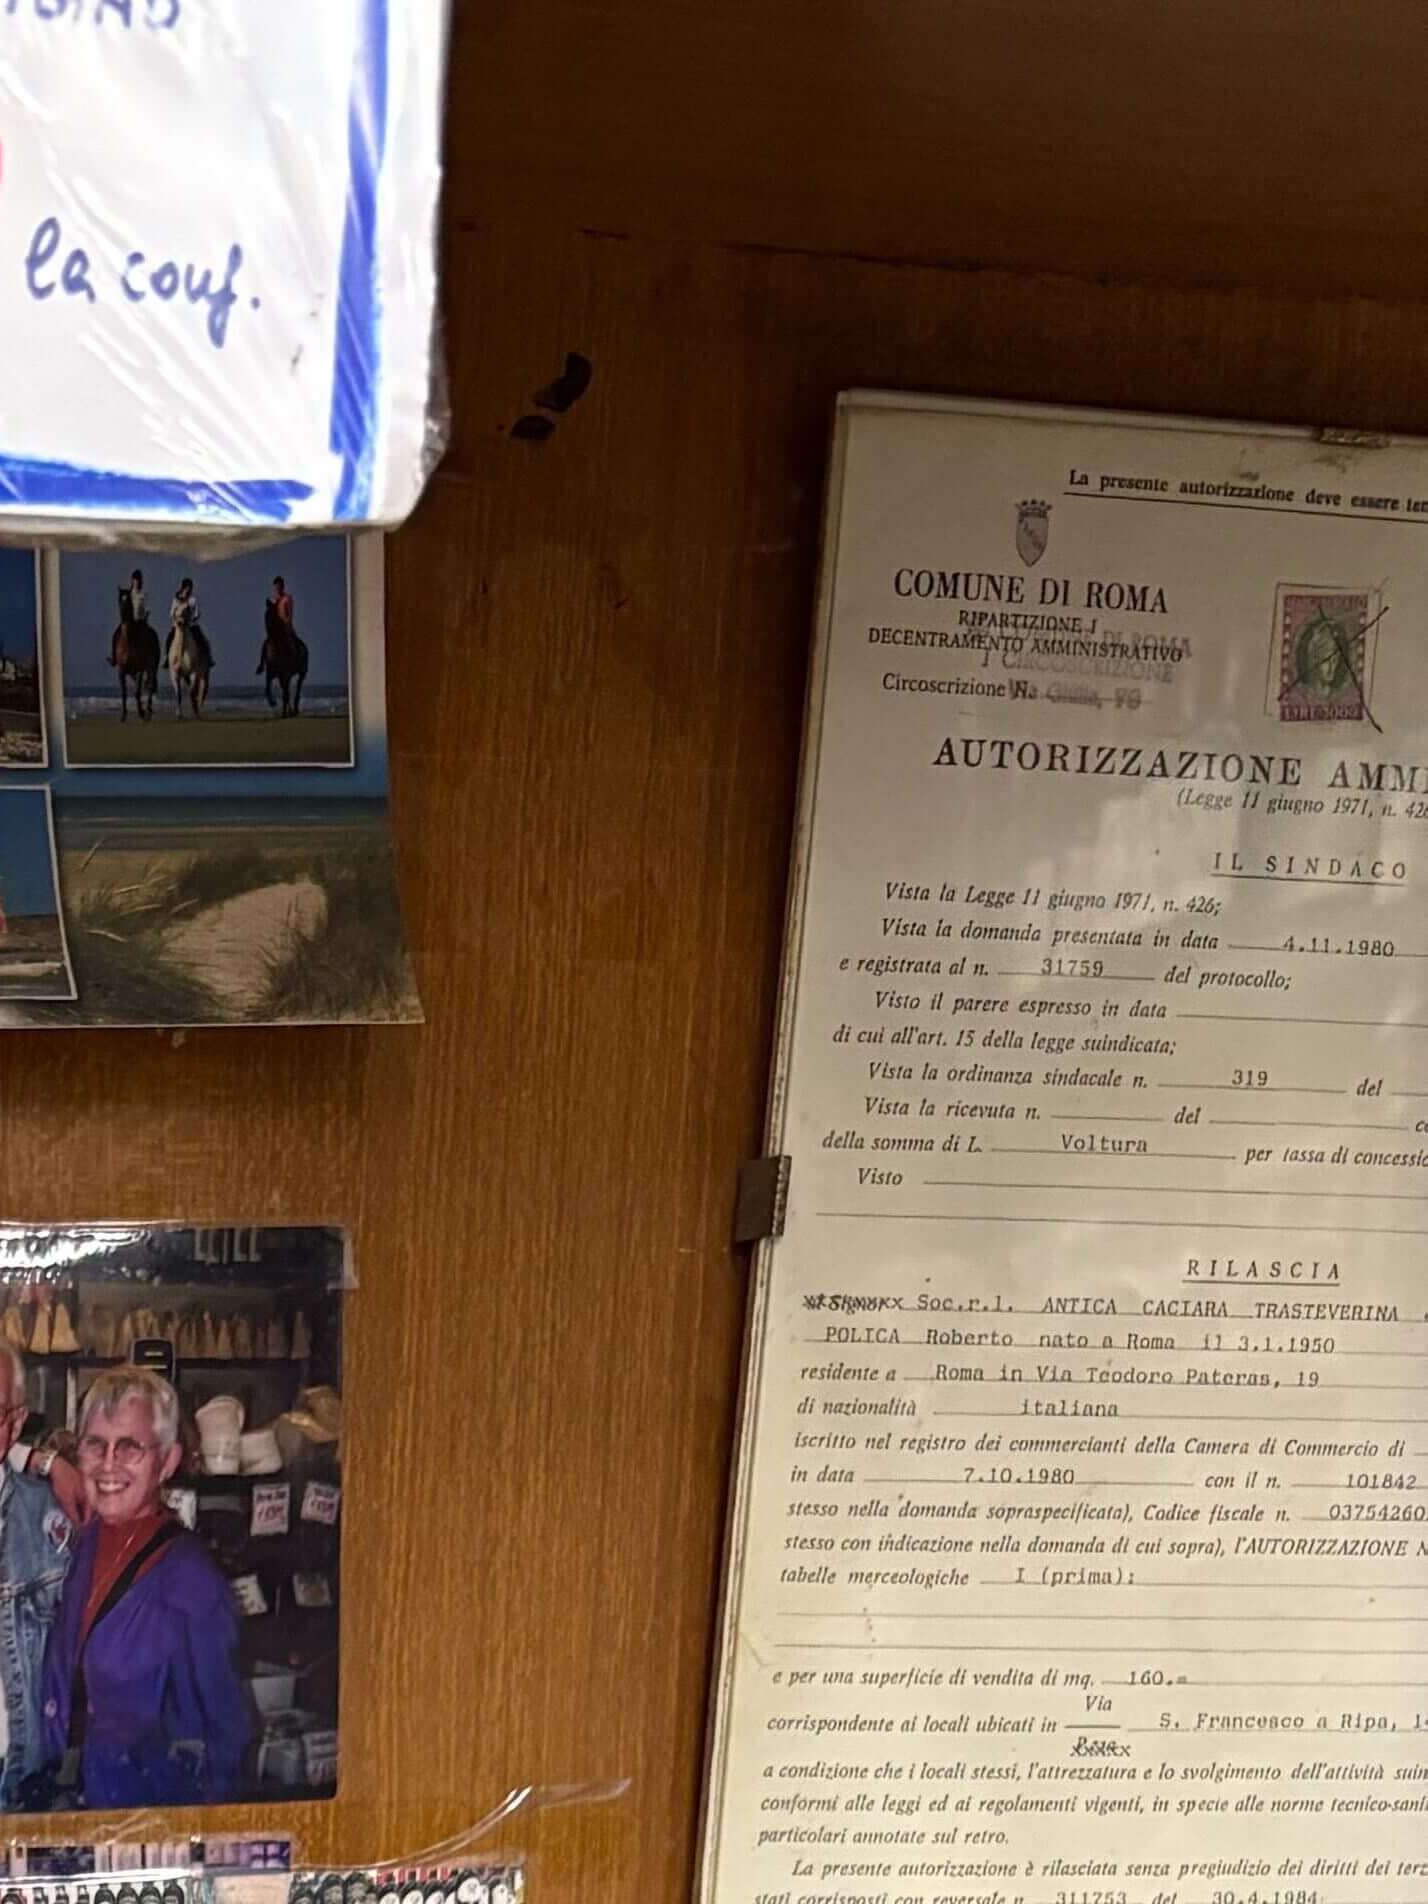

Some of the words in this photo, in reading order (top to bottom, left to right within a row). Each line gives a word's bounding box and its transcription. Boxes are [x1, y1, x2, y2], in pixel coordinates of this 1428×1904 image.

[1069, 468, 1089, 486] La
[1099, 472, 1168, 494] presente
[1178, 481, 1295, 503] autorizzazione
[1305, 488, 1342, 507] deve
[1350, 495, 1400, 512] essere
[893, 568, 1025, 604] COMUNE
[1038, 577, 1070, 607] DI
[1084, 581, 1168, 614] ROMA
[932, 737, 1302, 786] AUTORIZZAZIONE
[1214, 852, 1243, 871] IL
[1265, 855, 1405, 878] SINDACO
[886, 881, 930, 901] Vista
[939, 883, 956, 902] la
[964, 885, 1016, 909] Legge
[1022, 888, 1041, 906] 11
[1047, 889, 1106, 911] giugno
[1187, 1259, 1339, 1280] RILASCIA
[1040, 1297, 1117, 1315] ANTICA
[1142, 1300, 1228, 1318] CACIARA
[1248, 1302, 1399, 1322] TRASTEVERINA
[794, 1432, 856, 1448] iscritto
[865, 1432, 892, 1450] nel
[899, 1436, 966, 1453] registro
[974, 1433, 1002, 1451] dei
[1009, 1436, 1127, 1453] commercianti
[1134, 1435, 1175, 1454] della
[1184, 1437, 1249, 1454] Camera
[1258, 1437, 1277, 1455] di
[1284, 1439, 1379, 1456] Commercio
[1387, 1439, 1405, 1457] di
[766, 1715, 896, 1735] corrispondente
[899, 1716, 918, 1735] ai
[923, 1714, 970, 1732] locali
[976, 1715, 1035, 1733] ubicati
[1041, 1721, 1057, 1732] in
[1086, 1695, 1112, 1711] Via
[1197, 1713, 1304, 1729] Francesco
[1316, 1718, 1327, 1728] a
[1341, 1714, 1396, 1733] Ripa,
[792, 1860, 813, 1876] La
[821, 1863, 892, 1879] presente
[898, 1861, 1017, 1877] autorizzazione
[1042, 1859, 1117, 1876] rilasciata
[1127, 1864, 1170, 1877] senza
[1179, 1855, 1269, 1878] pregiudizio
[1274, 1855, 1302, 1878] dei
[1309, 1859, 1357, 1875] diritti
[1365, 1858, 1389, 1875] dei
